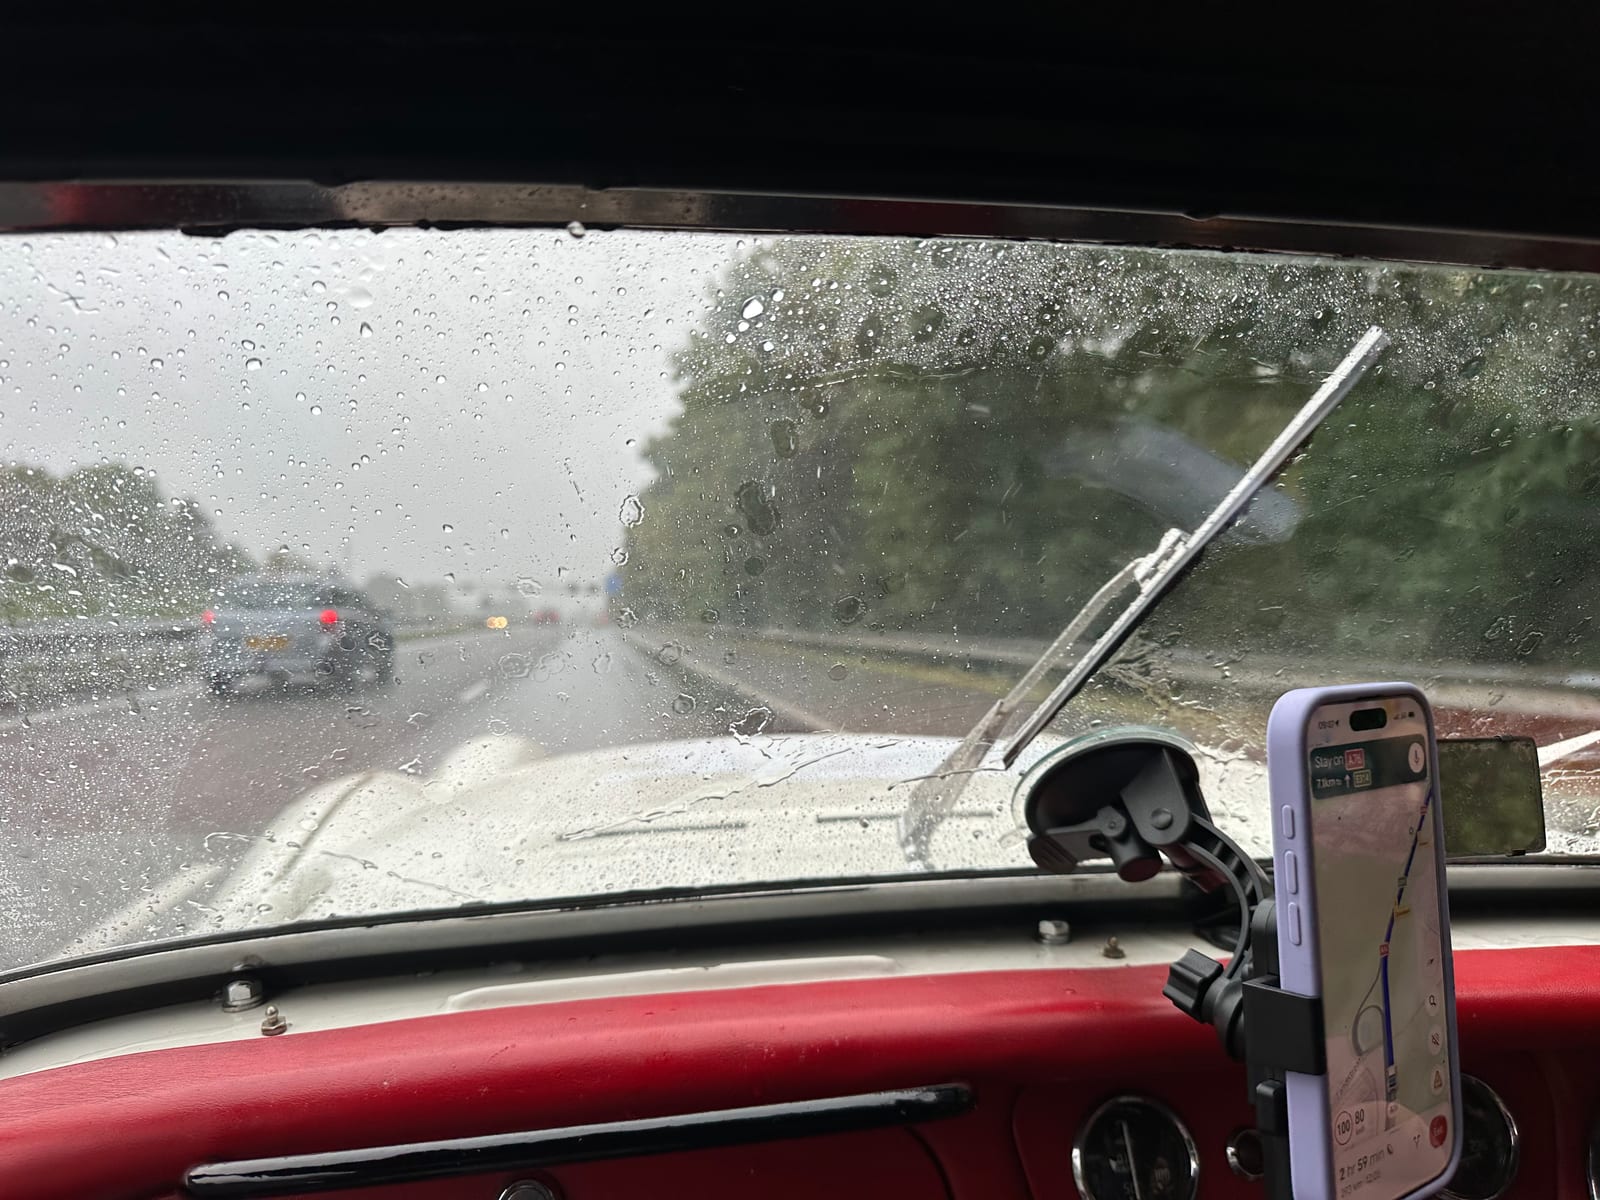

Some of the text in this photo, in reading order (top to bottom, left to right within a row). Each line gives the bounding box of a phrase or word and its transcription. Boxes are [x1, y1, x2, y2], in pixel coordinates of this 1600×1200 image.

[1314, 755, 1332, 769] Stay
[1333, 754, 1344, 766] on
[1354, 1108, 1365, 1125] 80
[1337, 1119, 1351, 1136] 100
[1339, 1167, 1346, 1181] 2
[1357, 1155, 1368, 1172] 59
